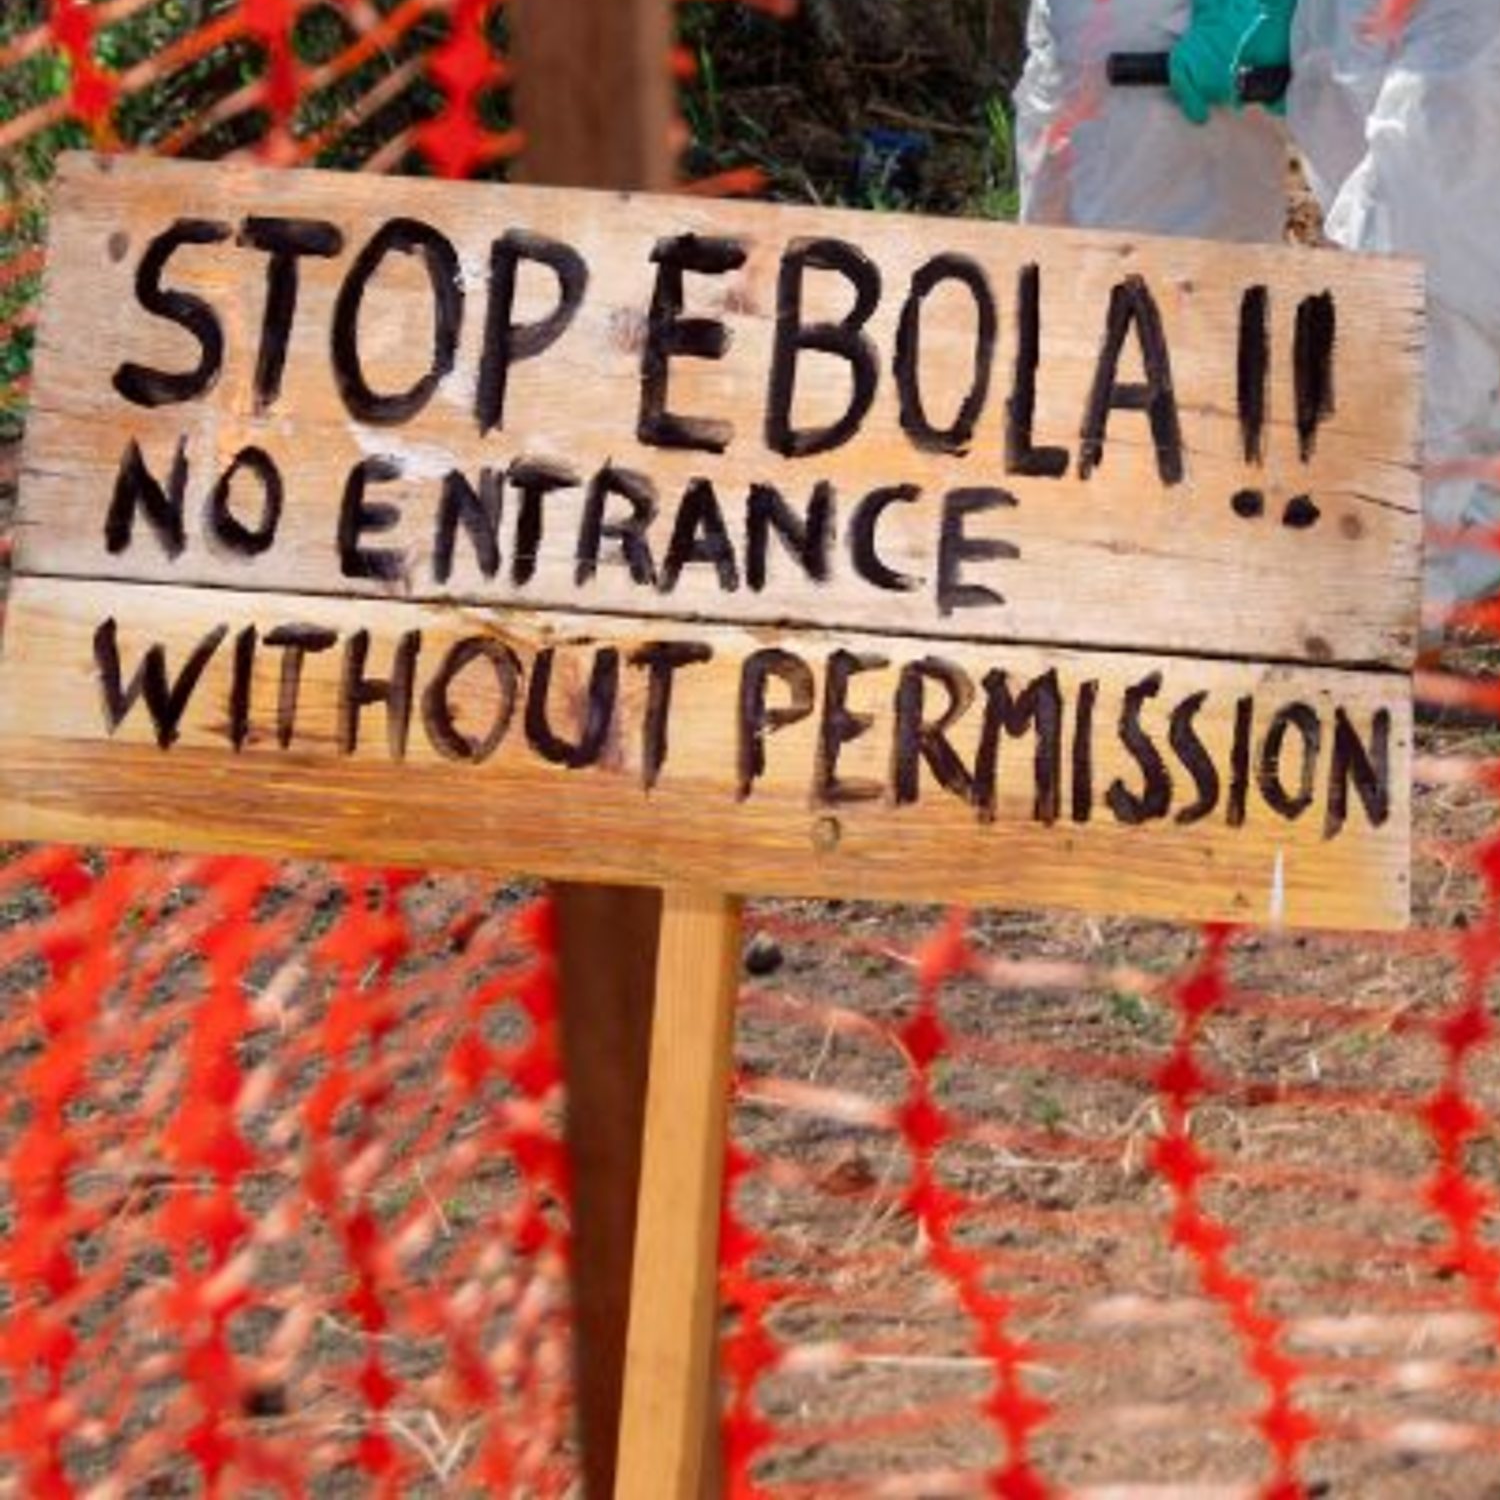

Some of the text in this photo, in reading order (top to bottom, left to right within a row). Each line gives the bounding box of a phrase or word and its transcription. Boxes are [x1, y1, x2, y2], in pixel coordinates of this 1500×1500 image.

[112, 217, 588, 437] STOP
[637, 233, 1184, 485] EBOLA
[104, 435, 1020, 617] NO ENTRANCE
[93, 617, 1391, 841] WITHOUT PERMISSION
